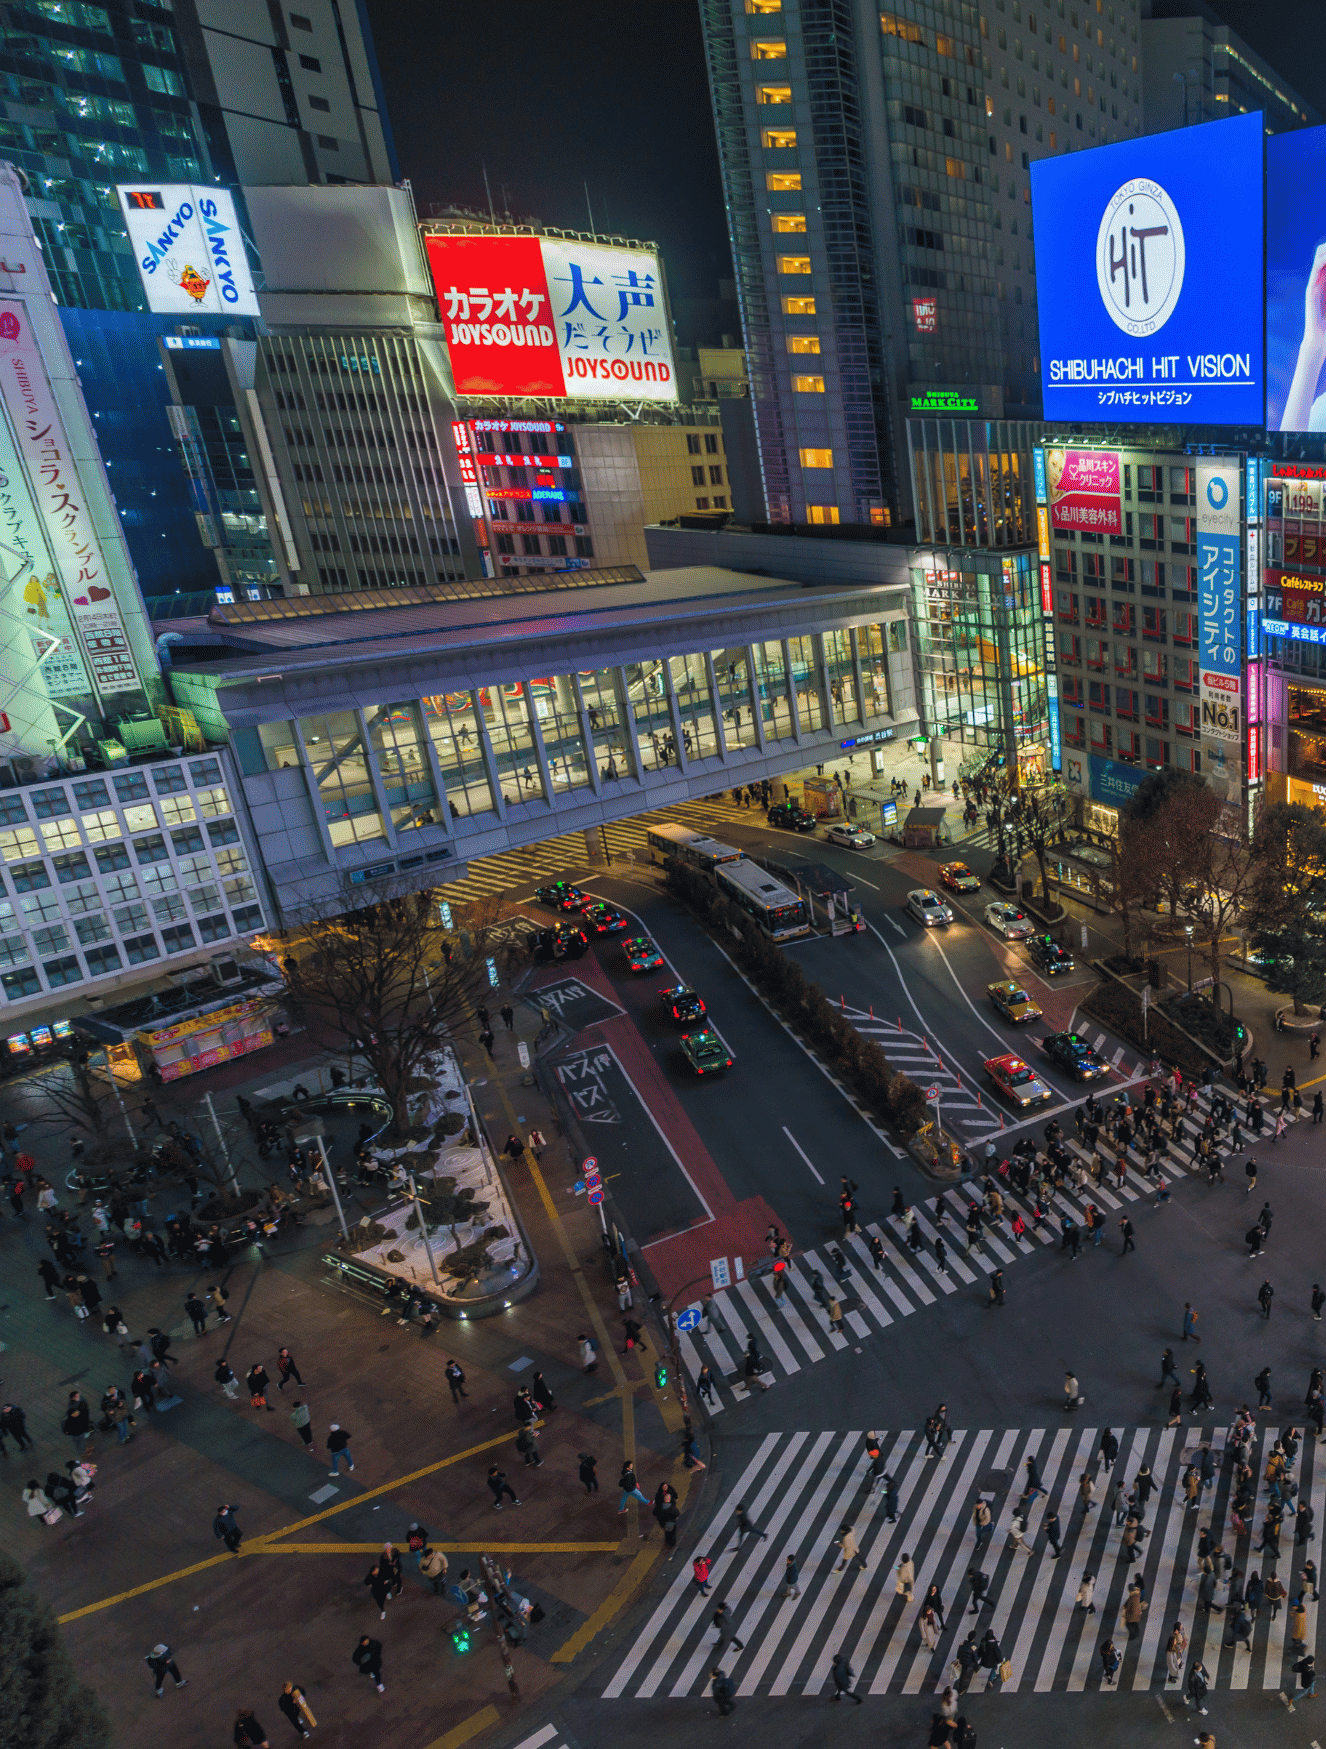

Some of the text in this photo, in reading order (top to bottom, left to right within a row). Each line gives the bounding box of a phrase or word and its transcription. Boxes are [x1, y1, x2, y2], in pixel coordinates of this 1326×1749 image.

[1138, 181, 1164, 201] GINZA
[142, 202, 194, 274] SANKYO
[200, 199, 239, 303] SANKYO
[444, 287, 545, 322] カラオケ
[553, 262, 655, 322] 大声
[451, 323, 553, 346] JOYSOUND
[567, 357, 671, 381] JOYSOUND
[1050, 353, 1250, 380] SHIBUHACHI HIT VISION
[12, 358, 38, 415] SHIBUYA
[1098, 391, 1192, 405] シブハチヒットビジョン
[475, 421, 508, 431] カラオケ
[510, 422, 551, 433] JOYSOUND
[1078, 458, 1116, 474] 品川スキン
[1079, 474, 1113, 488] クリニック
[1060, 506, 1118, 527] 品川美容外科
[1201, 513, 1234, 528] eyecity
[51, 493, 98, 583] スクランブル
[1202, 545, 1219, 661] アイシティ
[1223, 548, 1236, 663] コンタクトの
[1265, 621, 1286, 635] AEON
[1202, 699, 1240, 733] No.1
